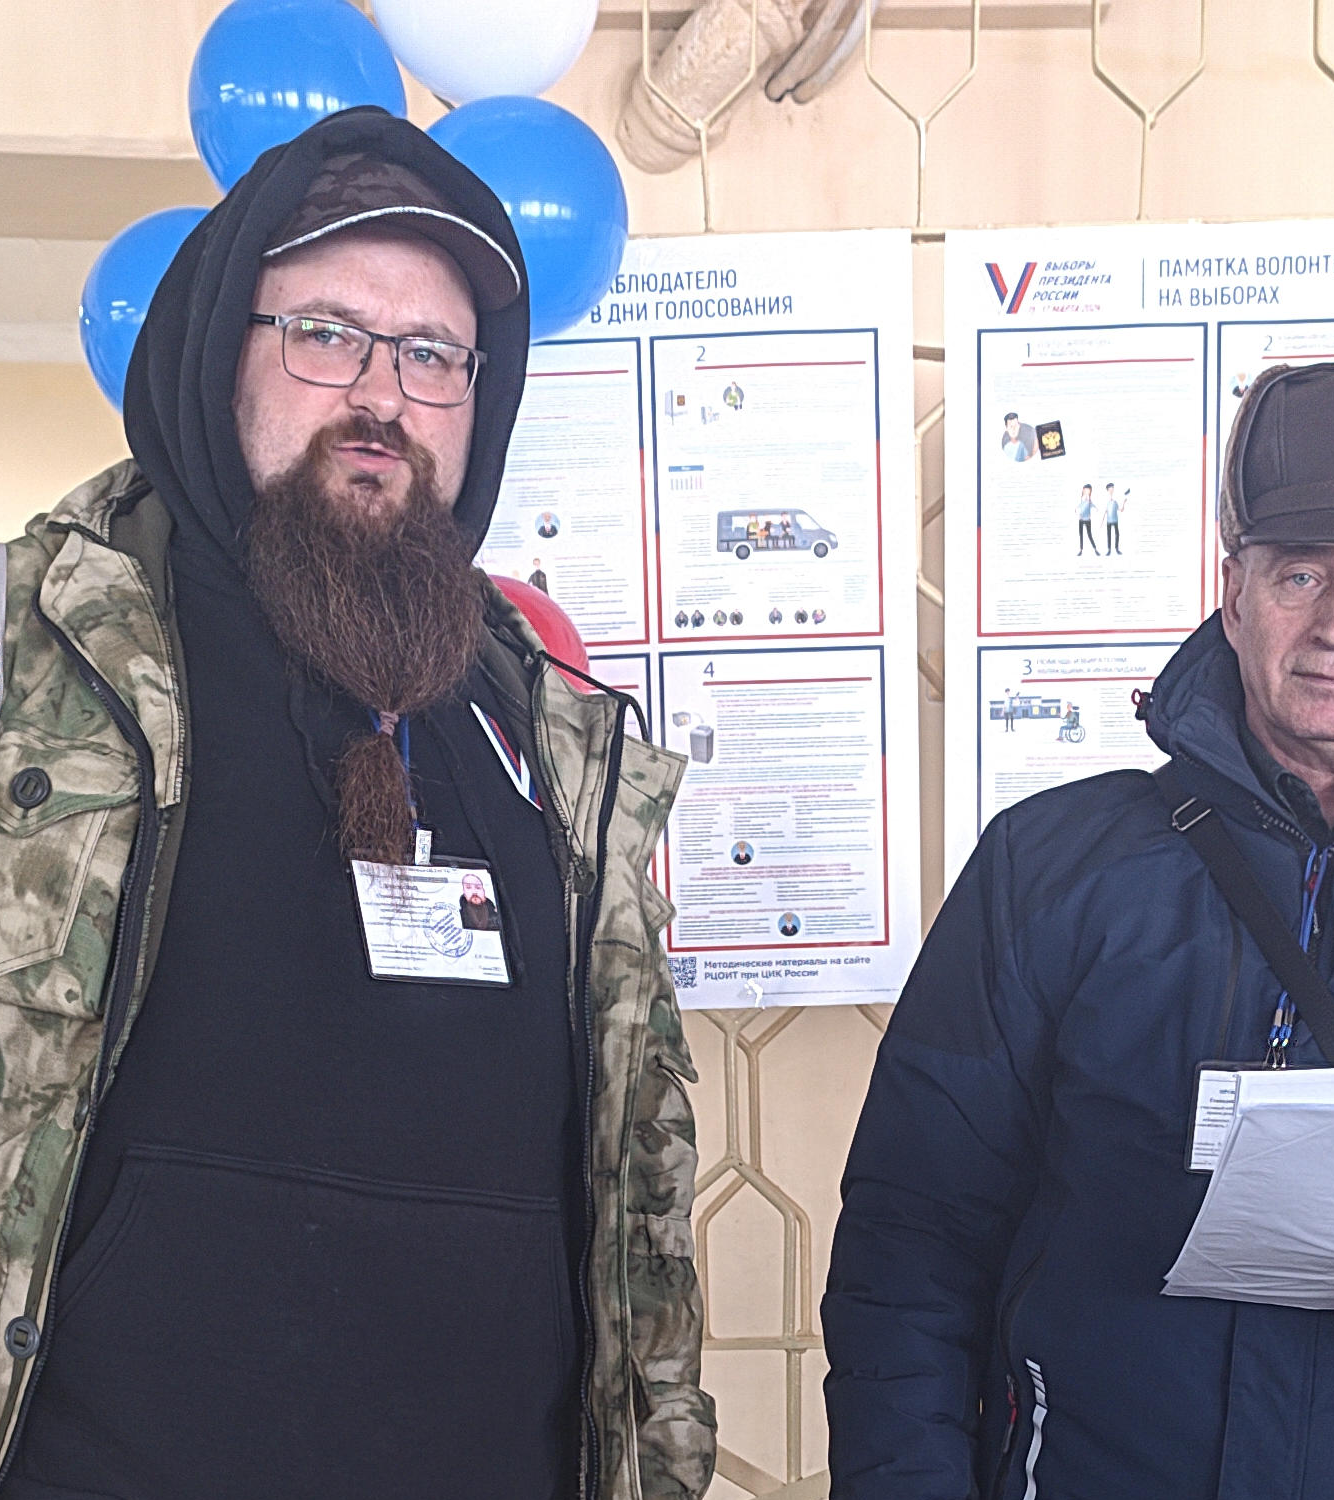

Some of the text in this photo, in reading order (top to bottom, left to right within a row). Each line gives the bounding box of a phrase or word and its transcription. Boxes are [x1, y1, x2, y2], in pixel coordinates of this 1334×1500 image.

[1044, 260, 1096, 271] ВЫБОРЫ
[1159, 257, 1249, 278] ПАМЯТКА
[609, 269, 737, 295] БЛЮДАТЕЛЮ
[1038, 274, 1111, 287] ПРЕЗИДЕНТА
[1033, 289, 1080, 301] РОССИИ
[1159, 285, 1280, 307] НА ВЫБОРАХ
[590, 295, 793, 325] В ДНИ ГОЛОСОВАНИЯ
[1026, 342, 1031, 358] 1
[1263, 335, 1273, 352] 2
[696, 346, 706, 362] 2
[703, 661, 715, 678] 4
[1022, 658, 1033, 676] 3
[703, 956, 871, 970] Методические материалы на сайте
[704, 971, 738, 981] РЦОИТ
[761, 970, 782, 980] ЦИК
[784, 969, 819, 978] России
